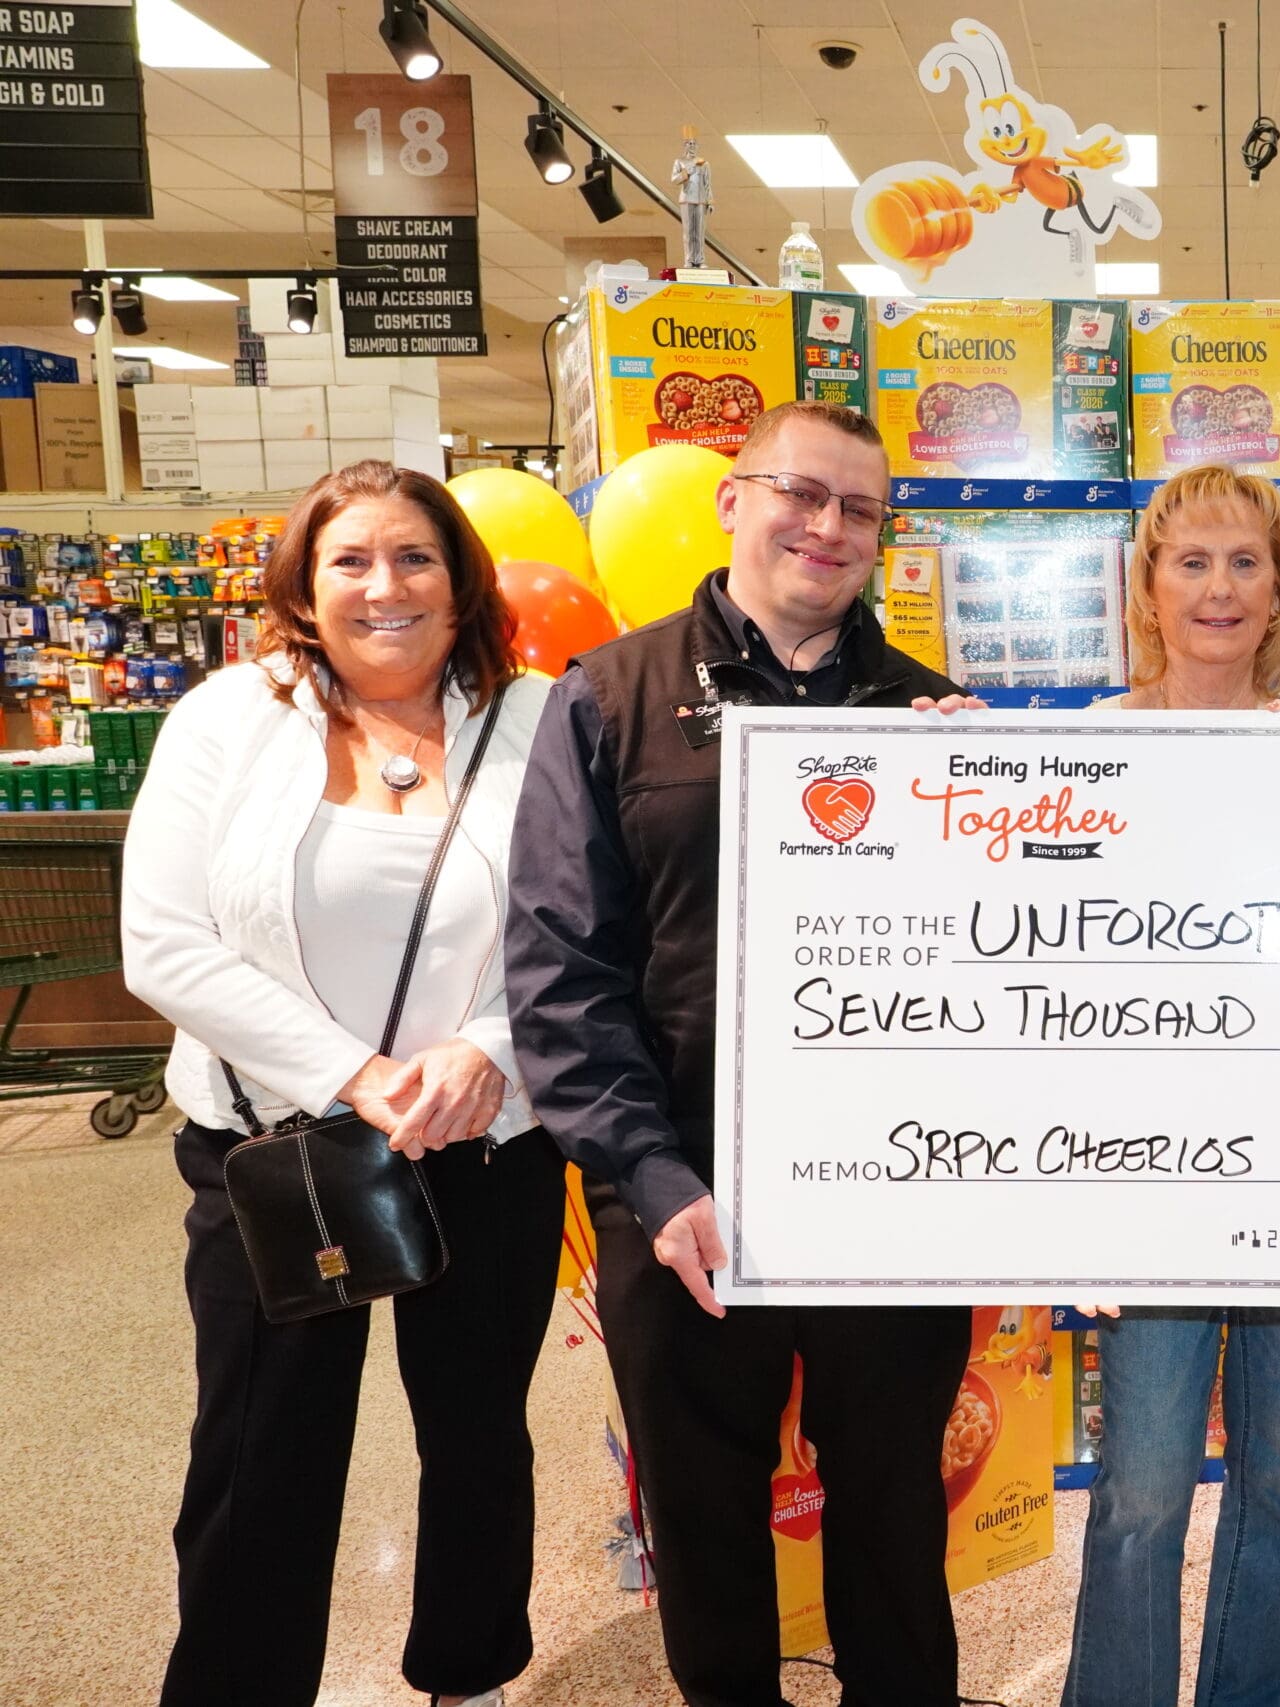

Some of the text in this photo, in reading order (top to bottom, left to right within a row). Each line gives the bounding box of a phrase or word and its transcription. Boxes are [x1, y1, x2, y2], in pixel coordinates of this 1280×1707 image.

[19, 10, 75, 35] SOAP
[30, 82, 46, 106] &
[52, 83, 105, 107] COLD
[353, 106, 449, 177] 18
[357, 221, 453, 236] SHAVE CREAM
[367, 244, 449, 260] DEODORANT
[403, 267, 447, 283] COLOR
[346, 290, 473, 306] HAIR ACCESSORIES
[374, 314, 452, 330] COSMETICS
[652, 317, 757, 351] Cheerios
[349, 337, 479, 353] SHAMPOO & CONDITIONER
[917, 331, 1017, 361] Cheerios
[1171, 334, 1268, 363] Cheerios
[722, 356, 749, 366] OATS
[982, 367, 1008, 375] OATS
[1234, 369, 1259, 377] OATS
[823, 391, 847, 403] 2026
[1081, 397, 1103, 409] 2026
[915, 440, 1011, 454] LOWER CHOLESTEROL
[1170, 441, 1263, 456] LOWER CHOLESTEROL
[796, 755, 878, 781] ShopRite
[950, 754, 1128, 783] Ending Hunger
[911, 778, 1128, 862] Together
[779, 842, 895, 860] Partners In Caring
[1032, 845, 1087, 857] Since 1999
[796, 915, 957, 936] PAY TO THE
[795, 945, 941, 967] ORDER OF
[793, 977, 985, 1040] SEVEN
[1004, 984, 1256, 1041] THOUSAND
[886, 1120, 1254, 1181] SRPIC CHEERIOS
[792, 1161, 882, 1182] MEMO
[775, 1497, 794, 1509] HELP
[776, 1491, 793, 1501] CAN
[975, 1504, 1020, 1533] Gluten
[1023, 1492, 1049, 1514] Free
